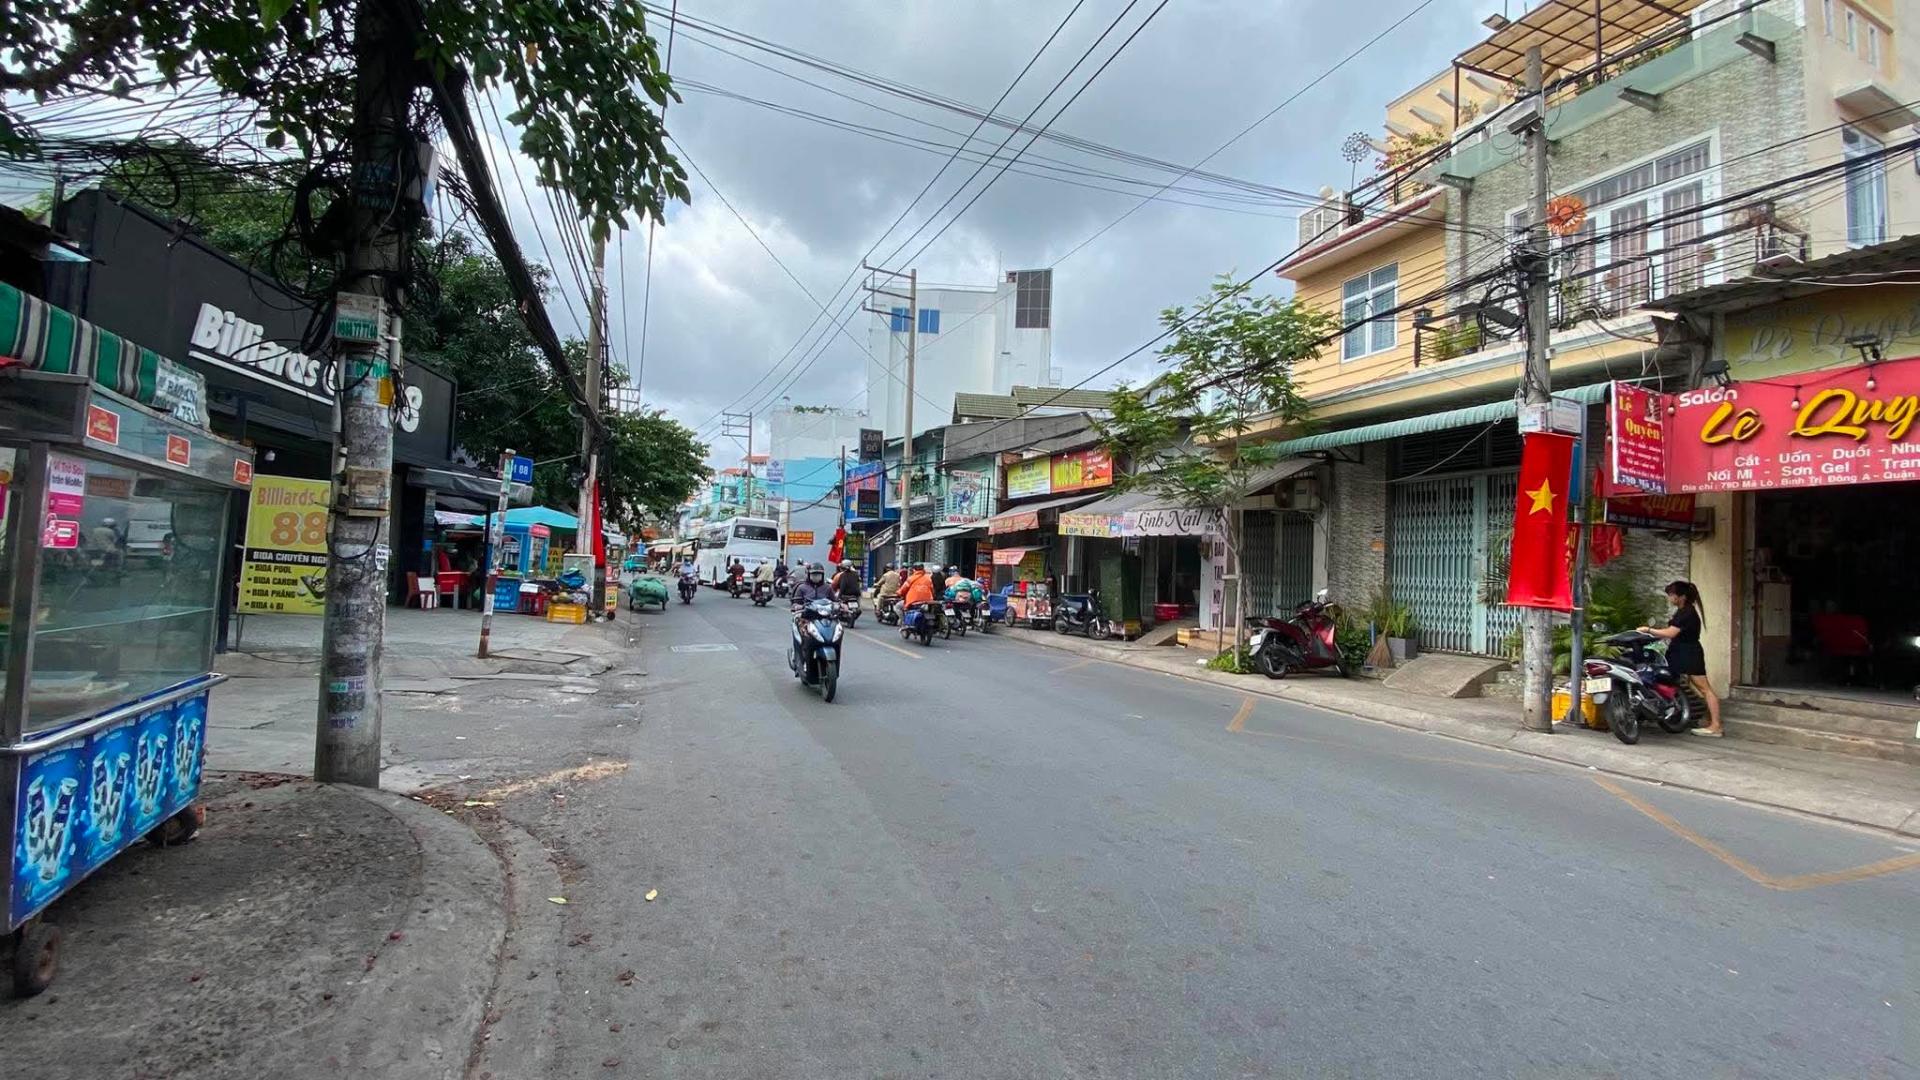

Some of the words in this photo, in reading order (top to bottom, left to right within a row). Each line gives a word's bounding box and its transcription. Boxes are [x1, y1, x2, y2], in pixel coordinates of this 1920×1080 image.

[190, 303, 321, 388] Billiards
[1700, 400, 1764, 445] Lê
[1788, 388, 1920, 442] Quy
[1821, 461, 1850, 474] Gel
[256, 487, 315, 506] Billiards
[1135, 511, 1164, 530] Linh
[1164, 507, 1203, 533] Nail
[270, 511, 328, 546] 88
[253, 551, 273, 561] BIDA
[254, 563, 272, 573] BIDA
[252, 575, 271, 585] BIDA
[251, 588, 269, 598] BIDA
[250, 601, 268, 610] BIDA
